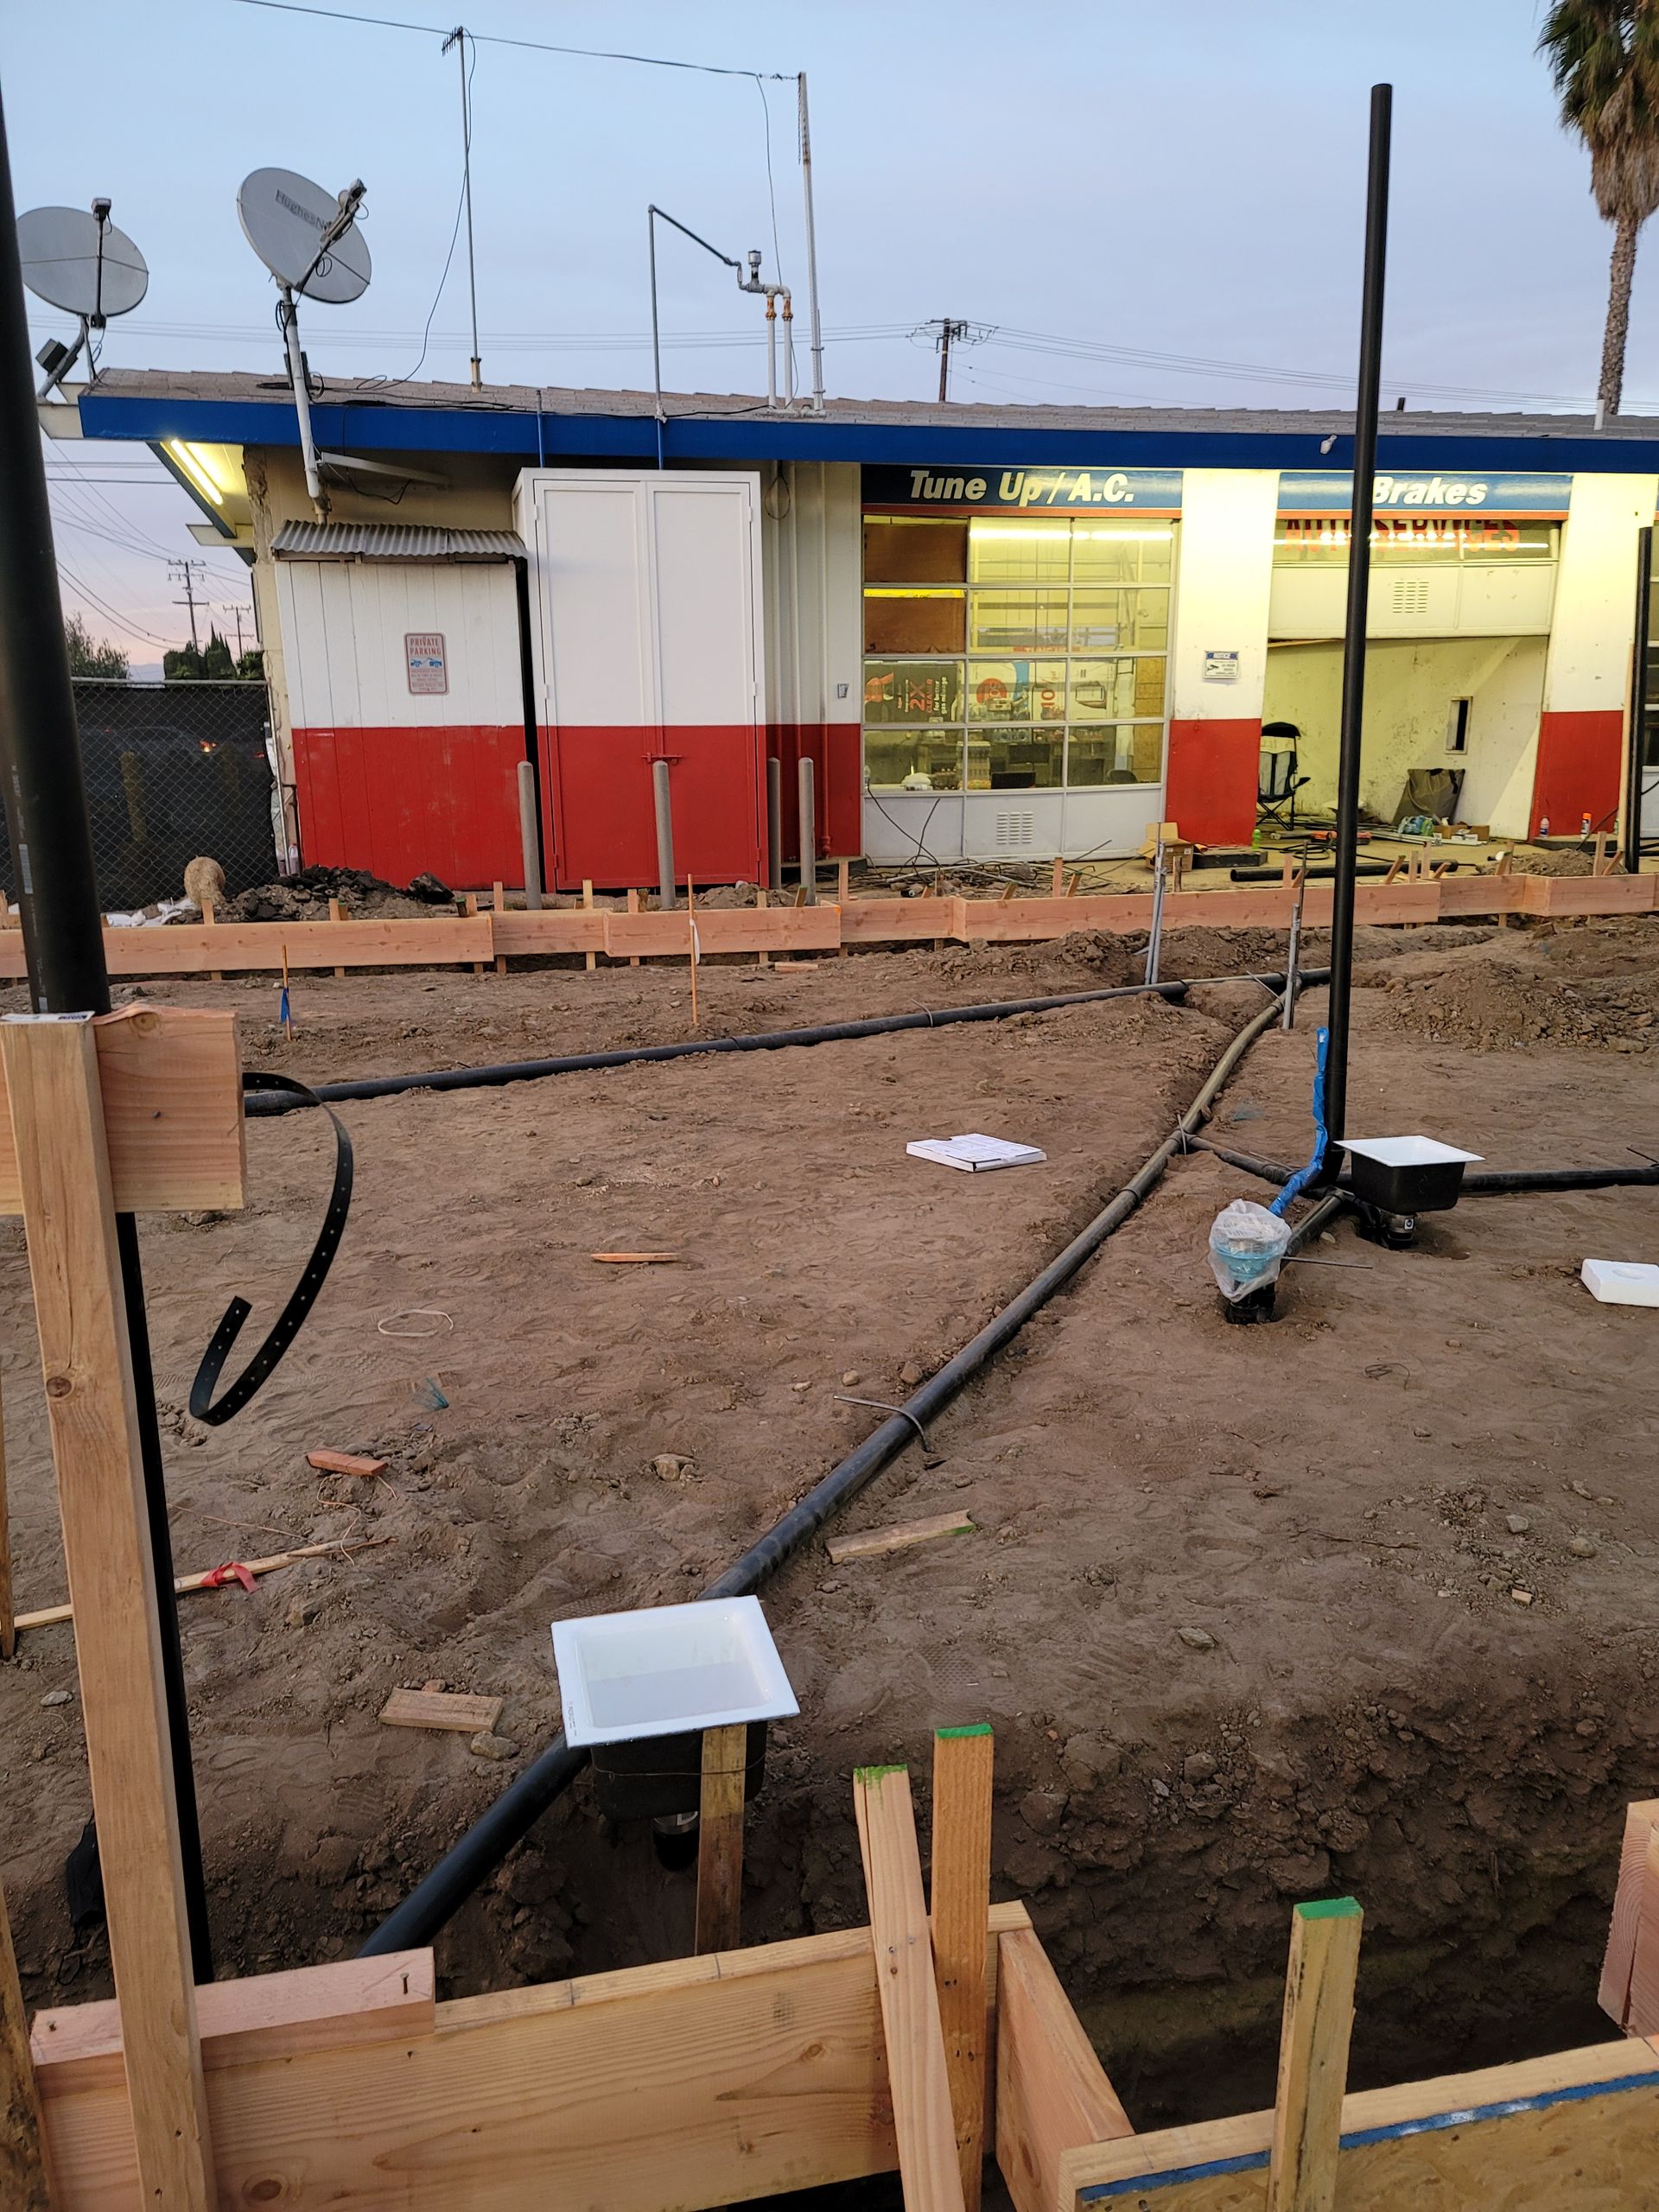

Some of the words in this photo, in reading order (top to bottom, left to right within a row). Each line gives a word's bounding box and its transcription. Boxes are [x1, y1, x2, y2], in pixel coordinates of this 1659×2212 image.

[276, 189, 331, 232] HughesN
[910, 470, 988, 500] Tune
[1372, 476, 1488, 505] Brakes
[1284, 519, 1351, 552] AUT
[410, 638, 438, 646] PRIVATE
[410, 647, 442, 656] PARKING
[909, 681, 925, 711] 2X
